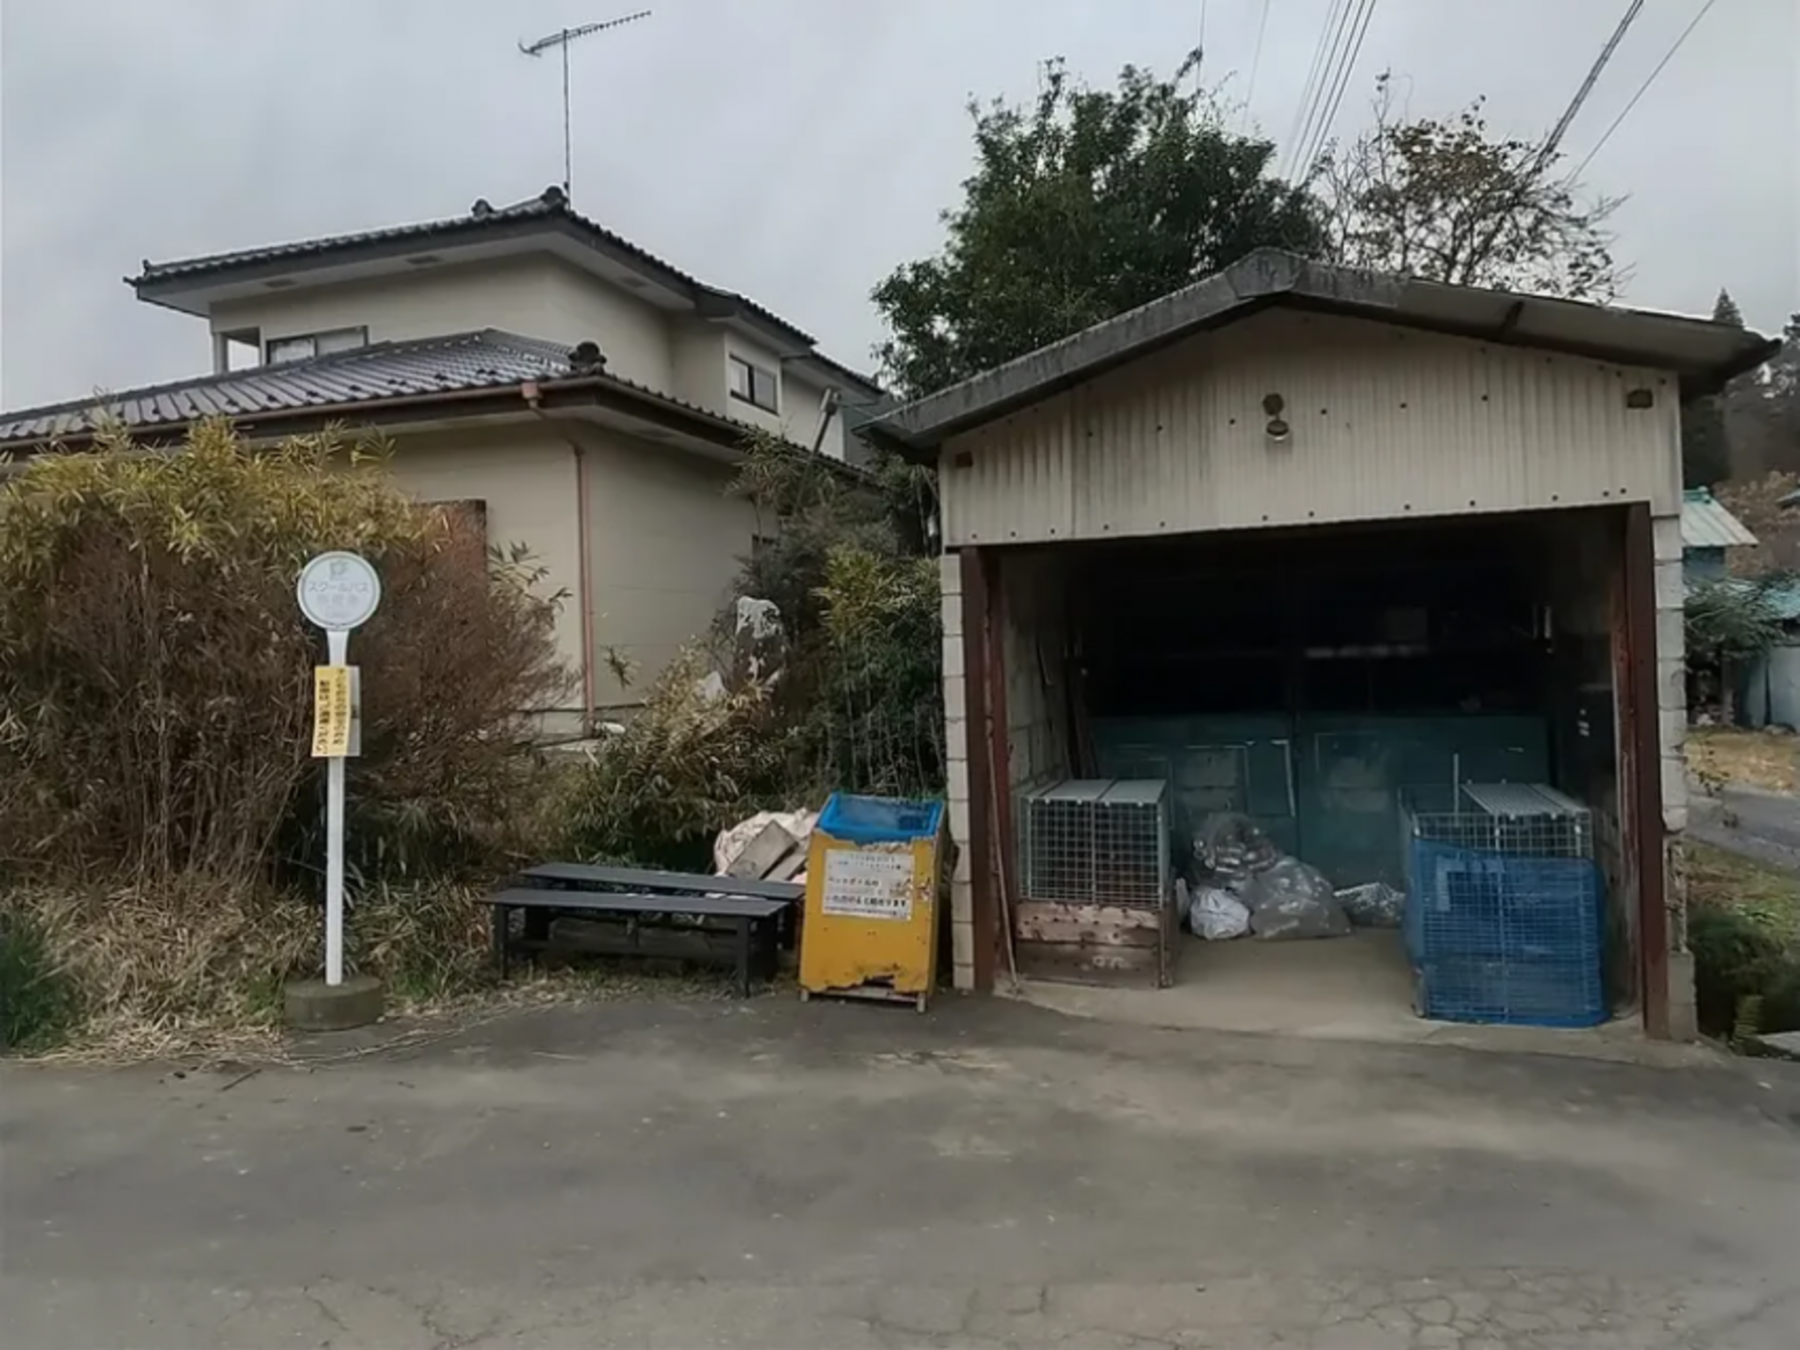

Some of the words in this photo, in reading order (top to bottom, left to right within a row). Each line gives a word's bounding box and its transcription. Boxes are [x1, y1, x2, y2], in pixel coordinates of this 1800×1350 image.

[308, 580, 369, 594] スクールバス
